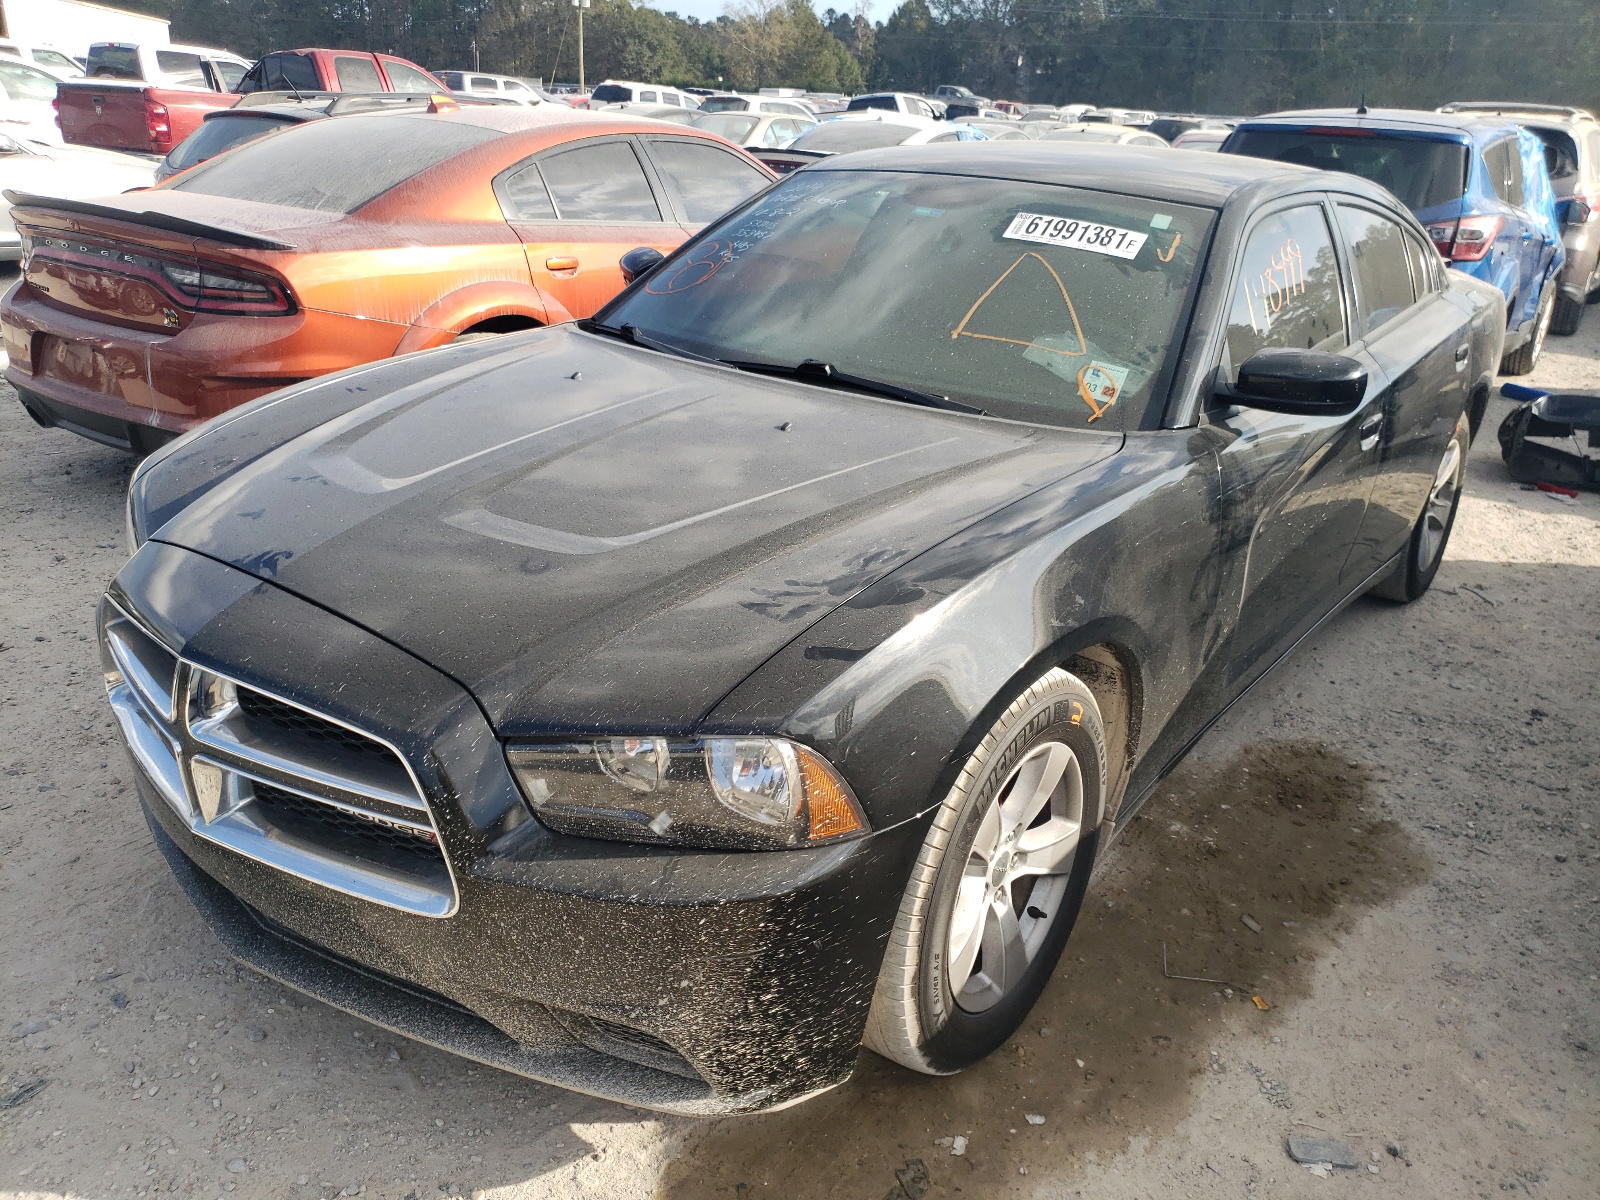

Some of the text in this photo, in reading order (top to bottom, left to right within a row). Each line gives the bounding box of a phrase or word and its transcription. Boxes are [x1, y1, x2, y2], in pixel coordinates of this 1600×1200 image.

[1025, 216, 1129, 249] 61991381
[1125, 239, 1137, 249] F
[45, 239, 137, 264] DODGE
[975, 705, 1050, 814] MICHELIN
